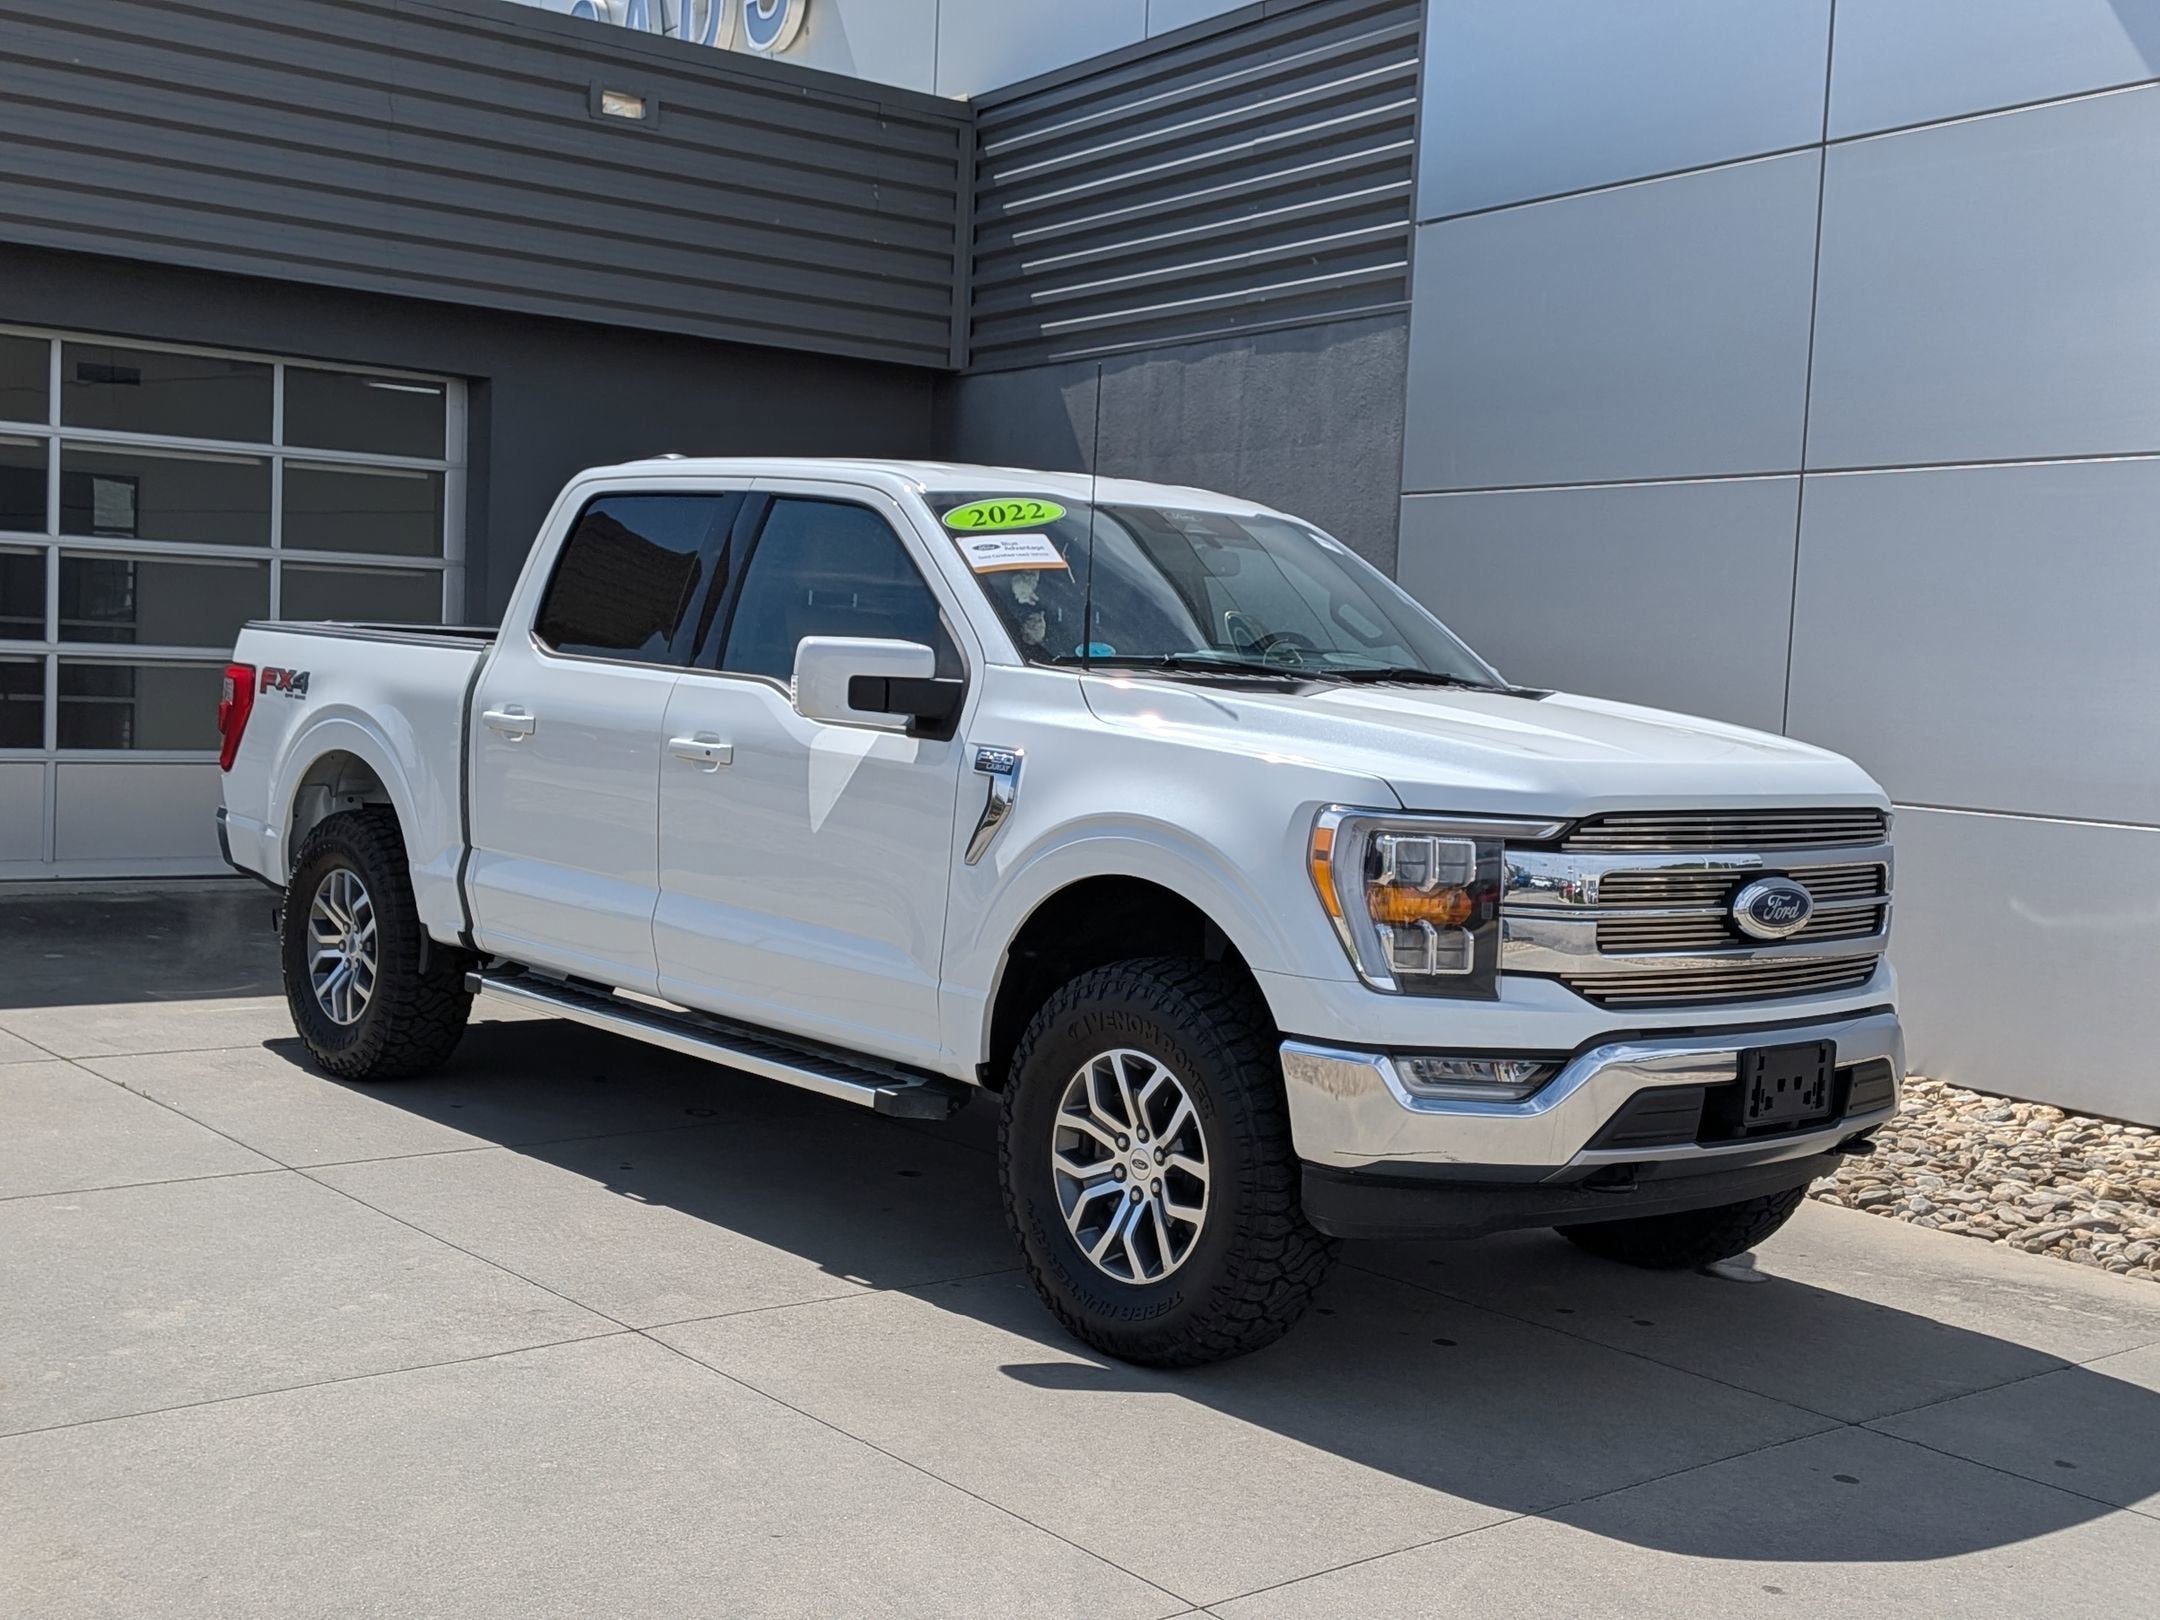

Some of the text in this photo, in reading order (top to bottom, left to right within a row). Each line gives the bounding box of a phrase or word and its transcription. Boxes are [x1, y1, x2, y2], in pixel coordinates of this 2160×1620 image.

[968, 502, 1045, 527] 2022
[260, 666, 310, 695] FX4
[1763, 894, 1801, 920] Ford
[1086, 1008, 1160, 1046] VENOM
